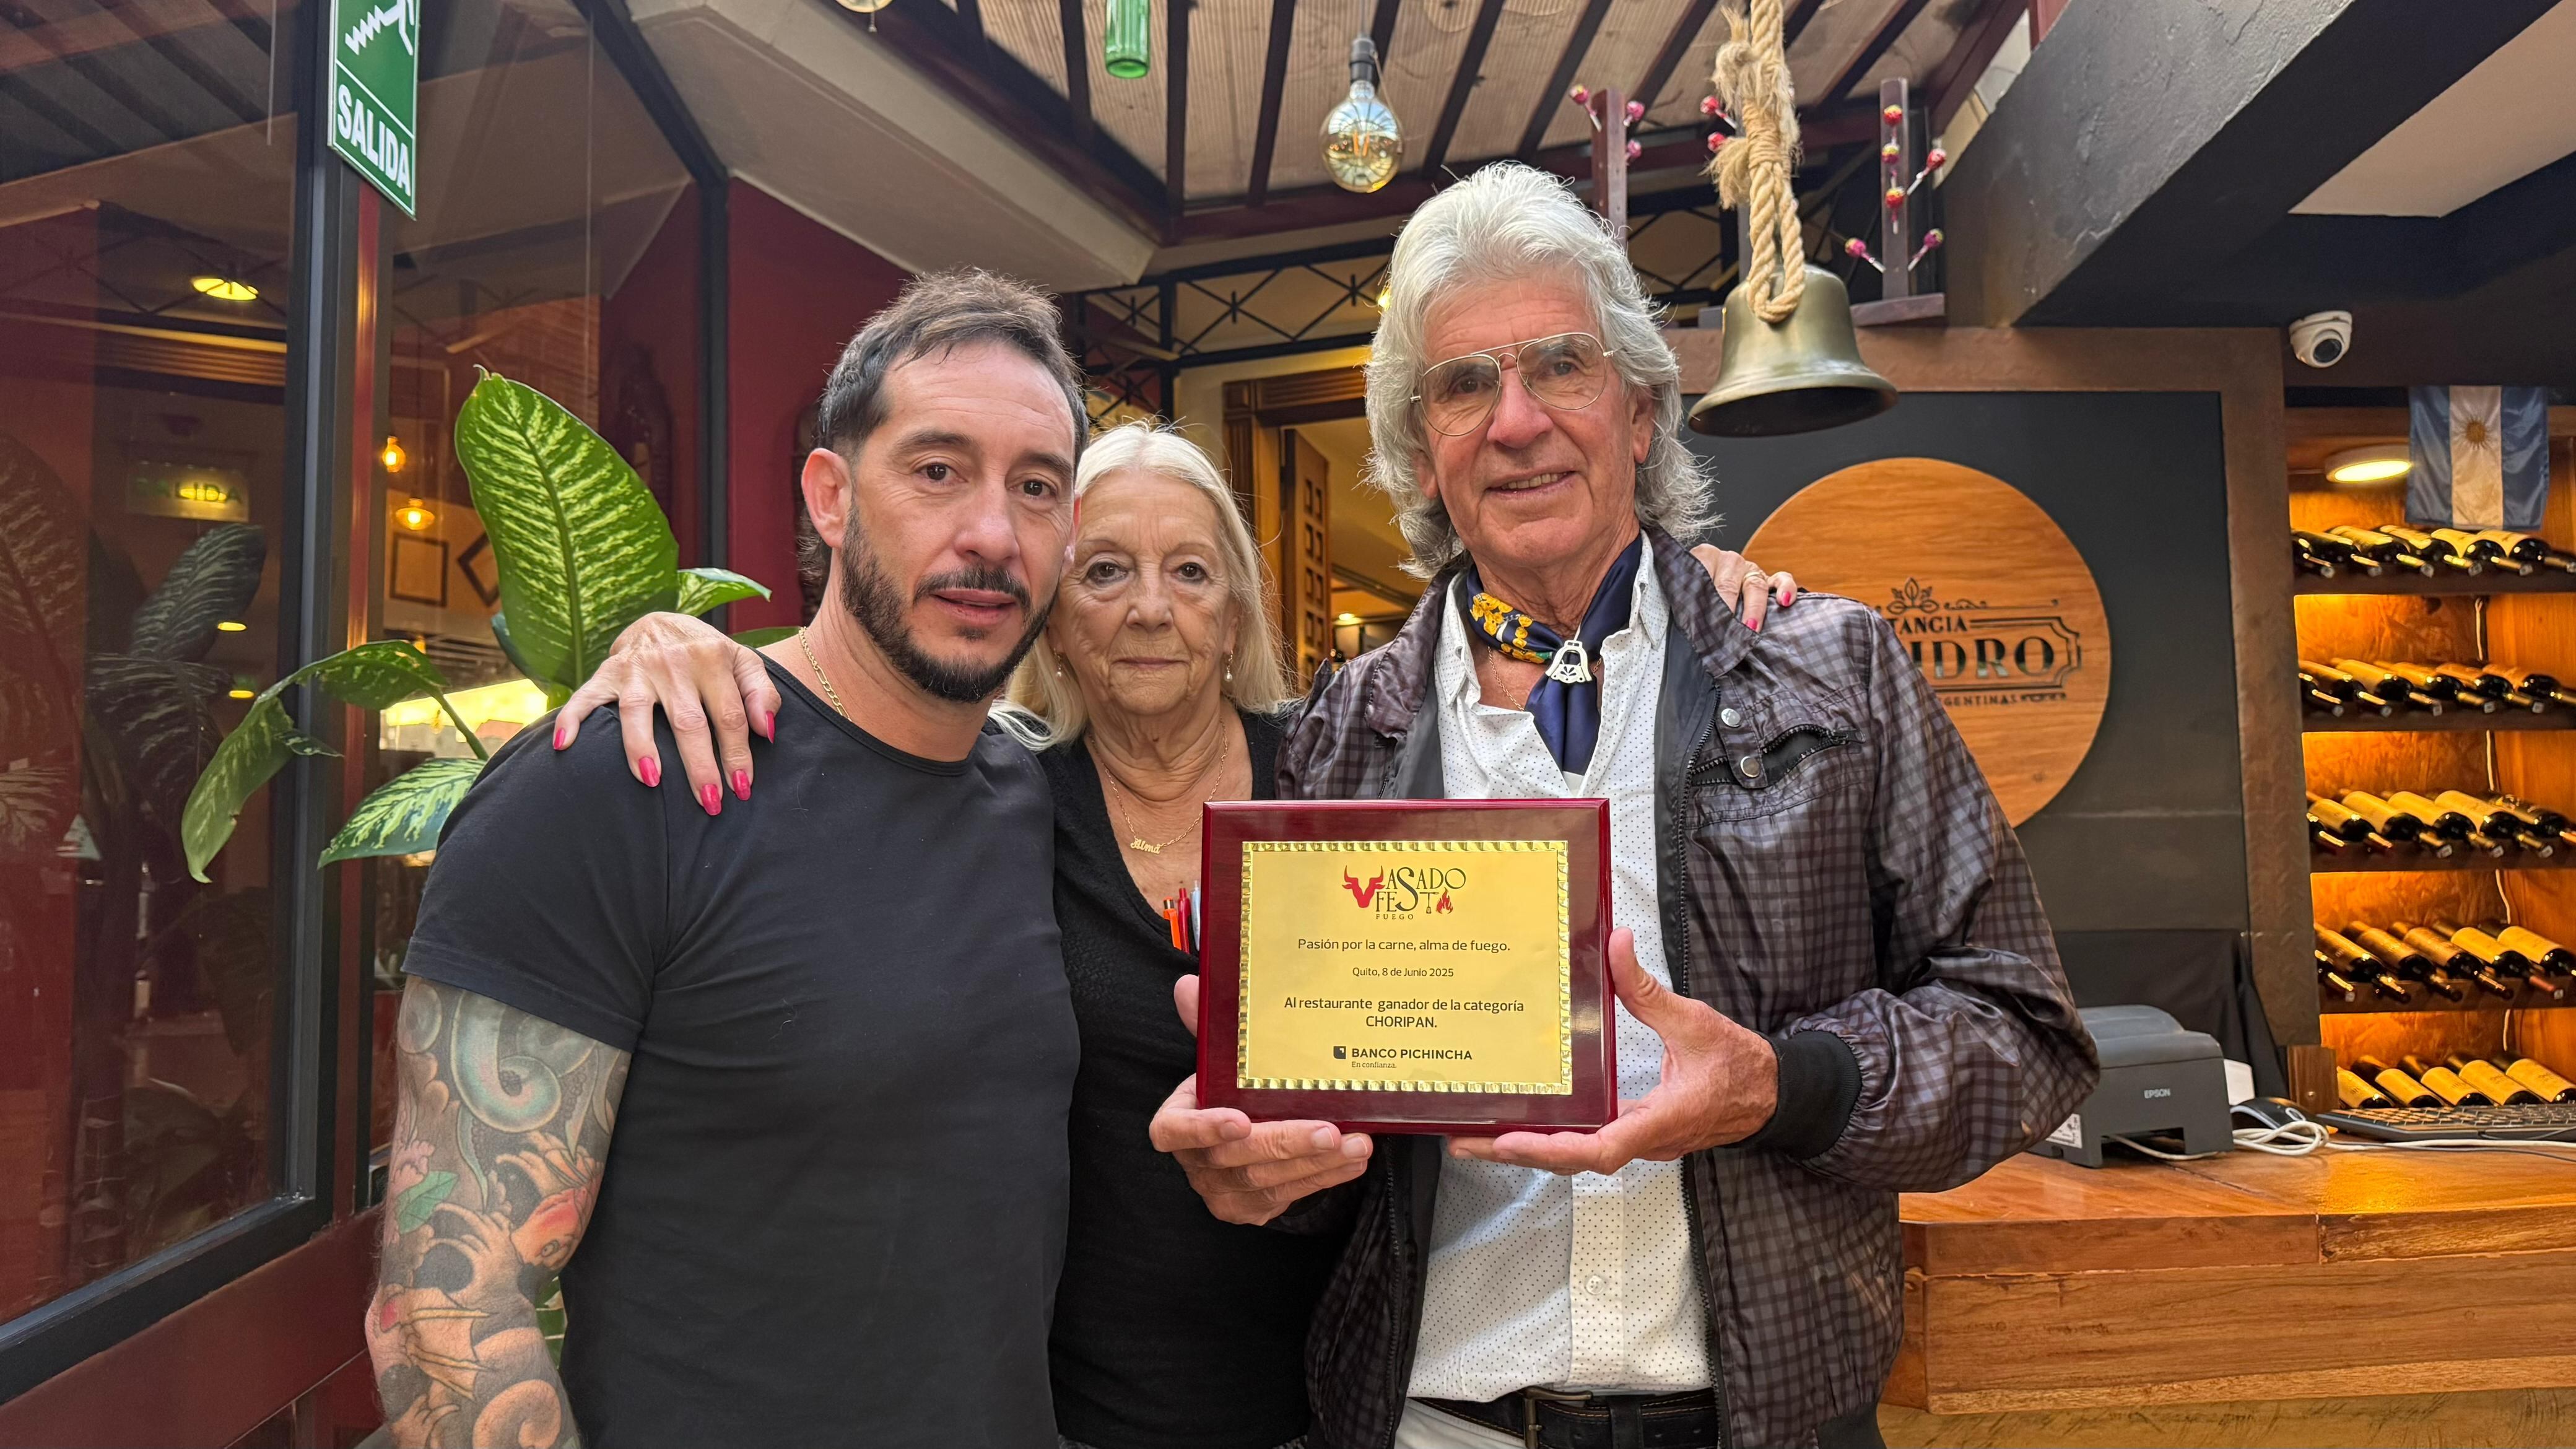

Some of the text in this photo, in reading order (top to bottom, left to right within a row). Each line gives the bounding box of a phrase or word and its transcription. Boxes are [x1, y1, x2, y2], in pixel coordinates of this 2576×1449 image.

[337, 84, 411, 197] SALIDA
[1910, 635, 2055, 679] IDRO
[1130, 839, 1160, 855] Alma
[1386, 866, 1466, 897] ASADO
[1298, 938, 1510, 954] Pasión por la carne, alma de fuego.
[1352, 967, 1454, 977] Quito, 8 de Junio 2025
[1284, 996, 1524, 1014] Al restaurante ganador de la categoría
[1365, 1016, 1437, 1029] CHORIPAN.
[1351, 1048, 1473, 1060] BANCO PICHINCHA
[2144, 1088, 2170, 1099] EPSON
